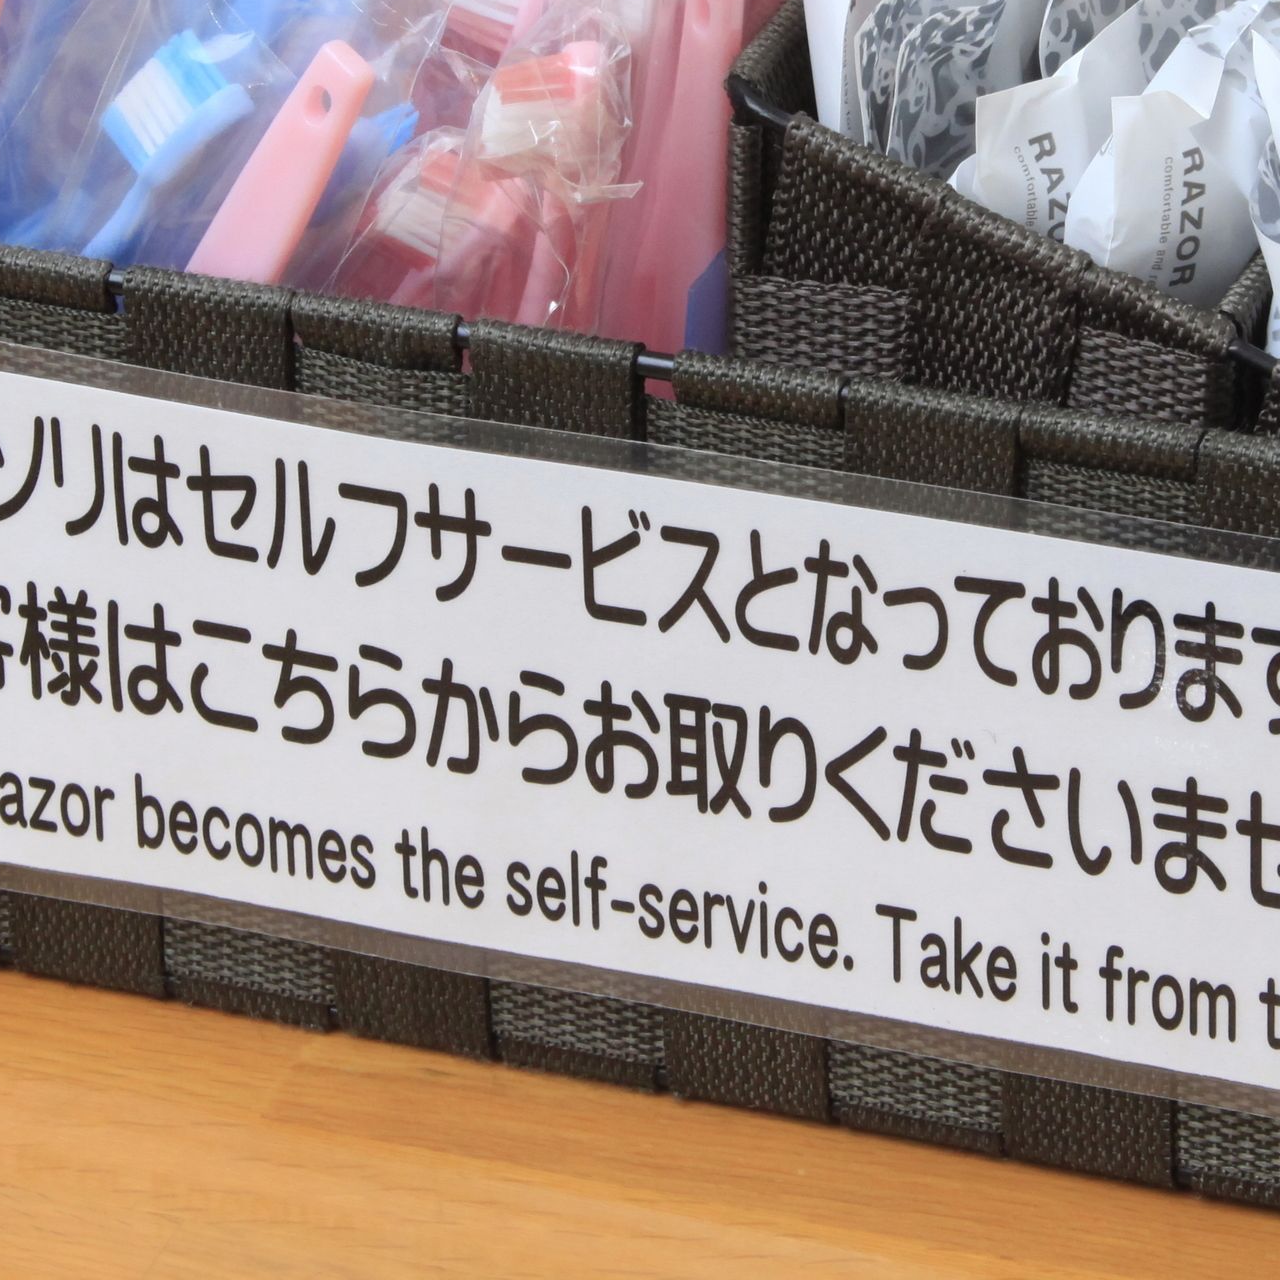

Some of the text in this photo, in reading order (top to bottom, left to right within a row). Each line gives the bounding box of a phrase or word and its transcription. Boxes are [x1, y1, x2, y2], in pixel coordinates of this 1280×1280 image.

[1014, 145, 1038, 227] comfortable
[1159, 157, 1174, 243] comfortable
[1169, 147, 1206, 287] RAZOR
[1152, 250, 1166, 271] and
[135, 773, 376, 890] becomes
[394, 826, 486, 909] the
[506, 850, 855, 971] self-service.
[875, 903, 1018, 1001] Take
[1041, 932, 1079, 1013] it
[1099, 945, 1237, 1043] from
